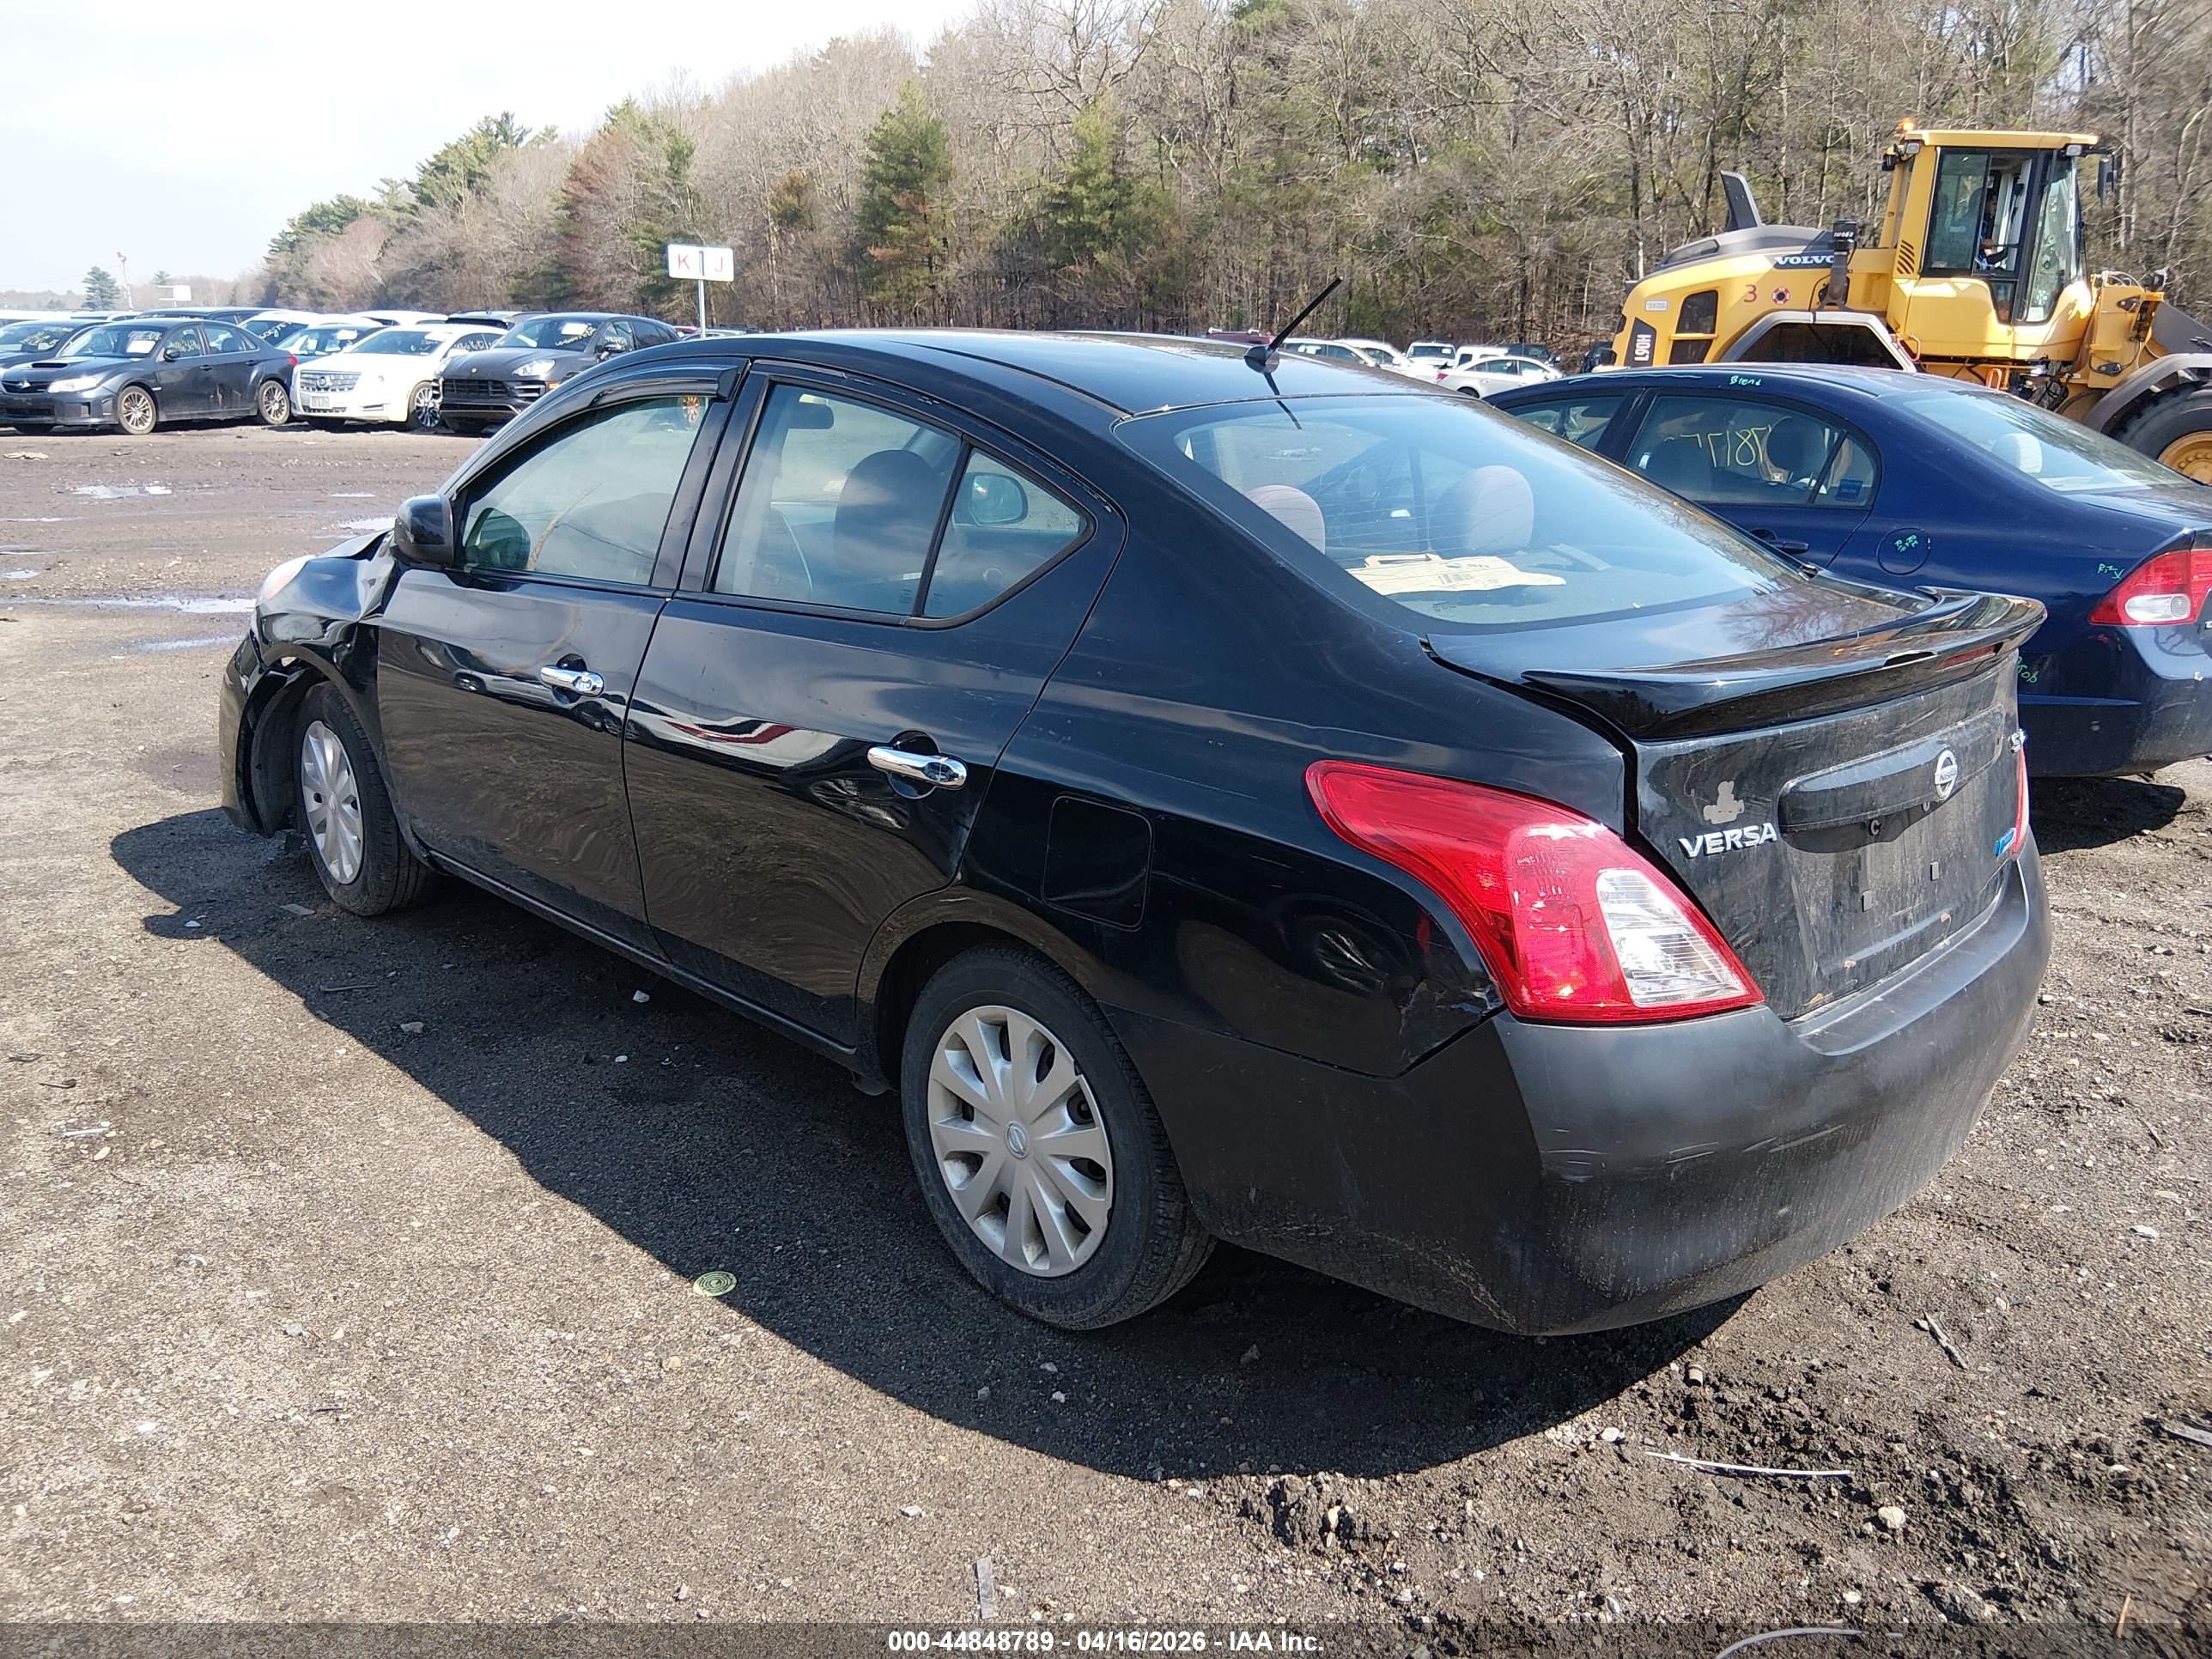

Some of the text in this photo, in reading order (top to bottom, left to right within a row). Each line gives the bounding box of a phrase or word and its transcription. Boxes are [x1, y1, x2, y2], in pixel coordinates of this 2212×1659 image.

[678, 253, 724, 273] K J
[1743, 284, 1758, 303] 3
[1634, 334, 1653, 362] L90H
[1677, 822, 1778, 859] VERSA
